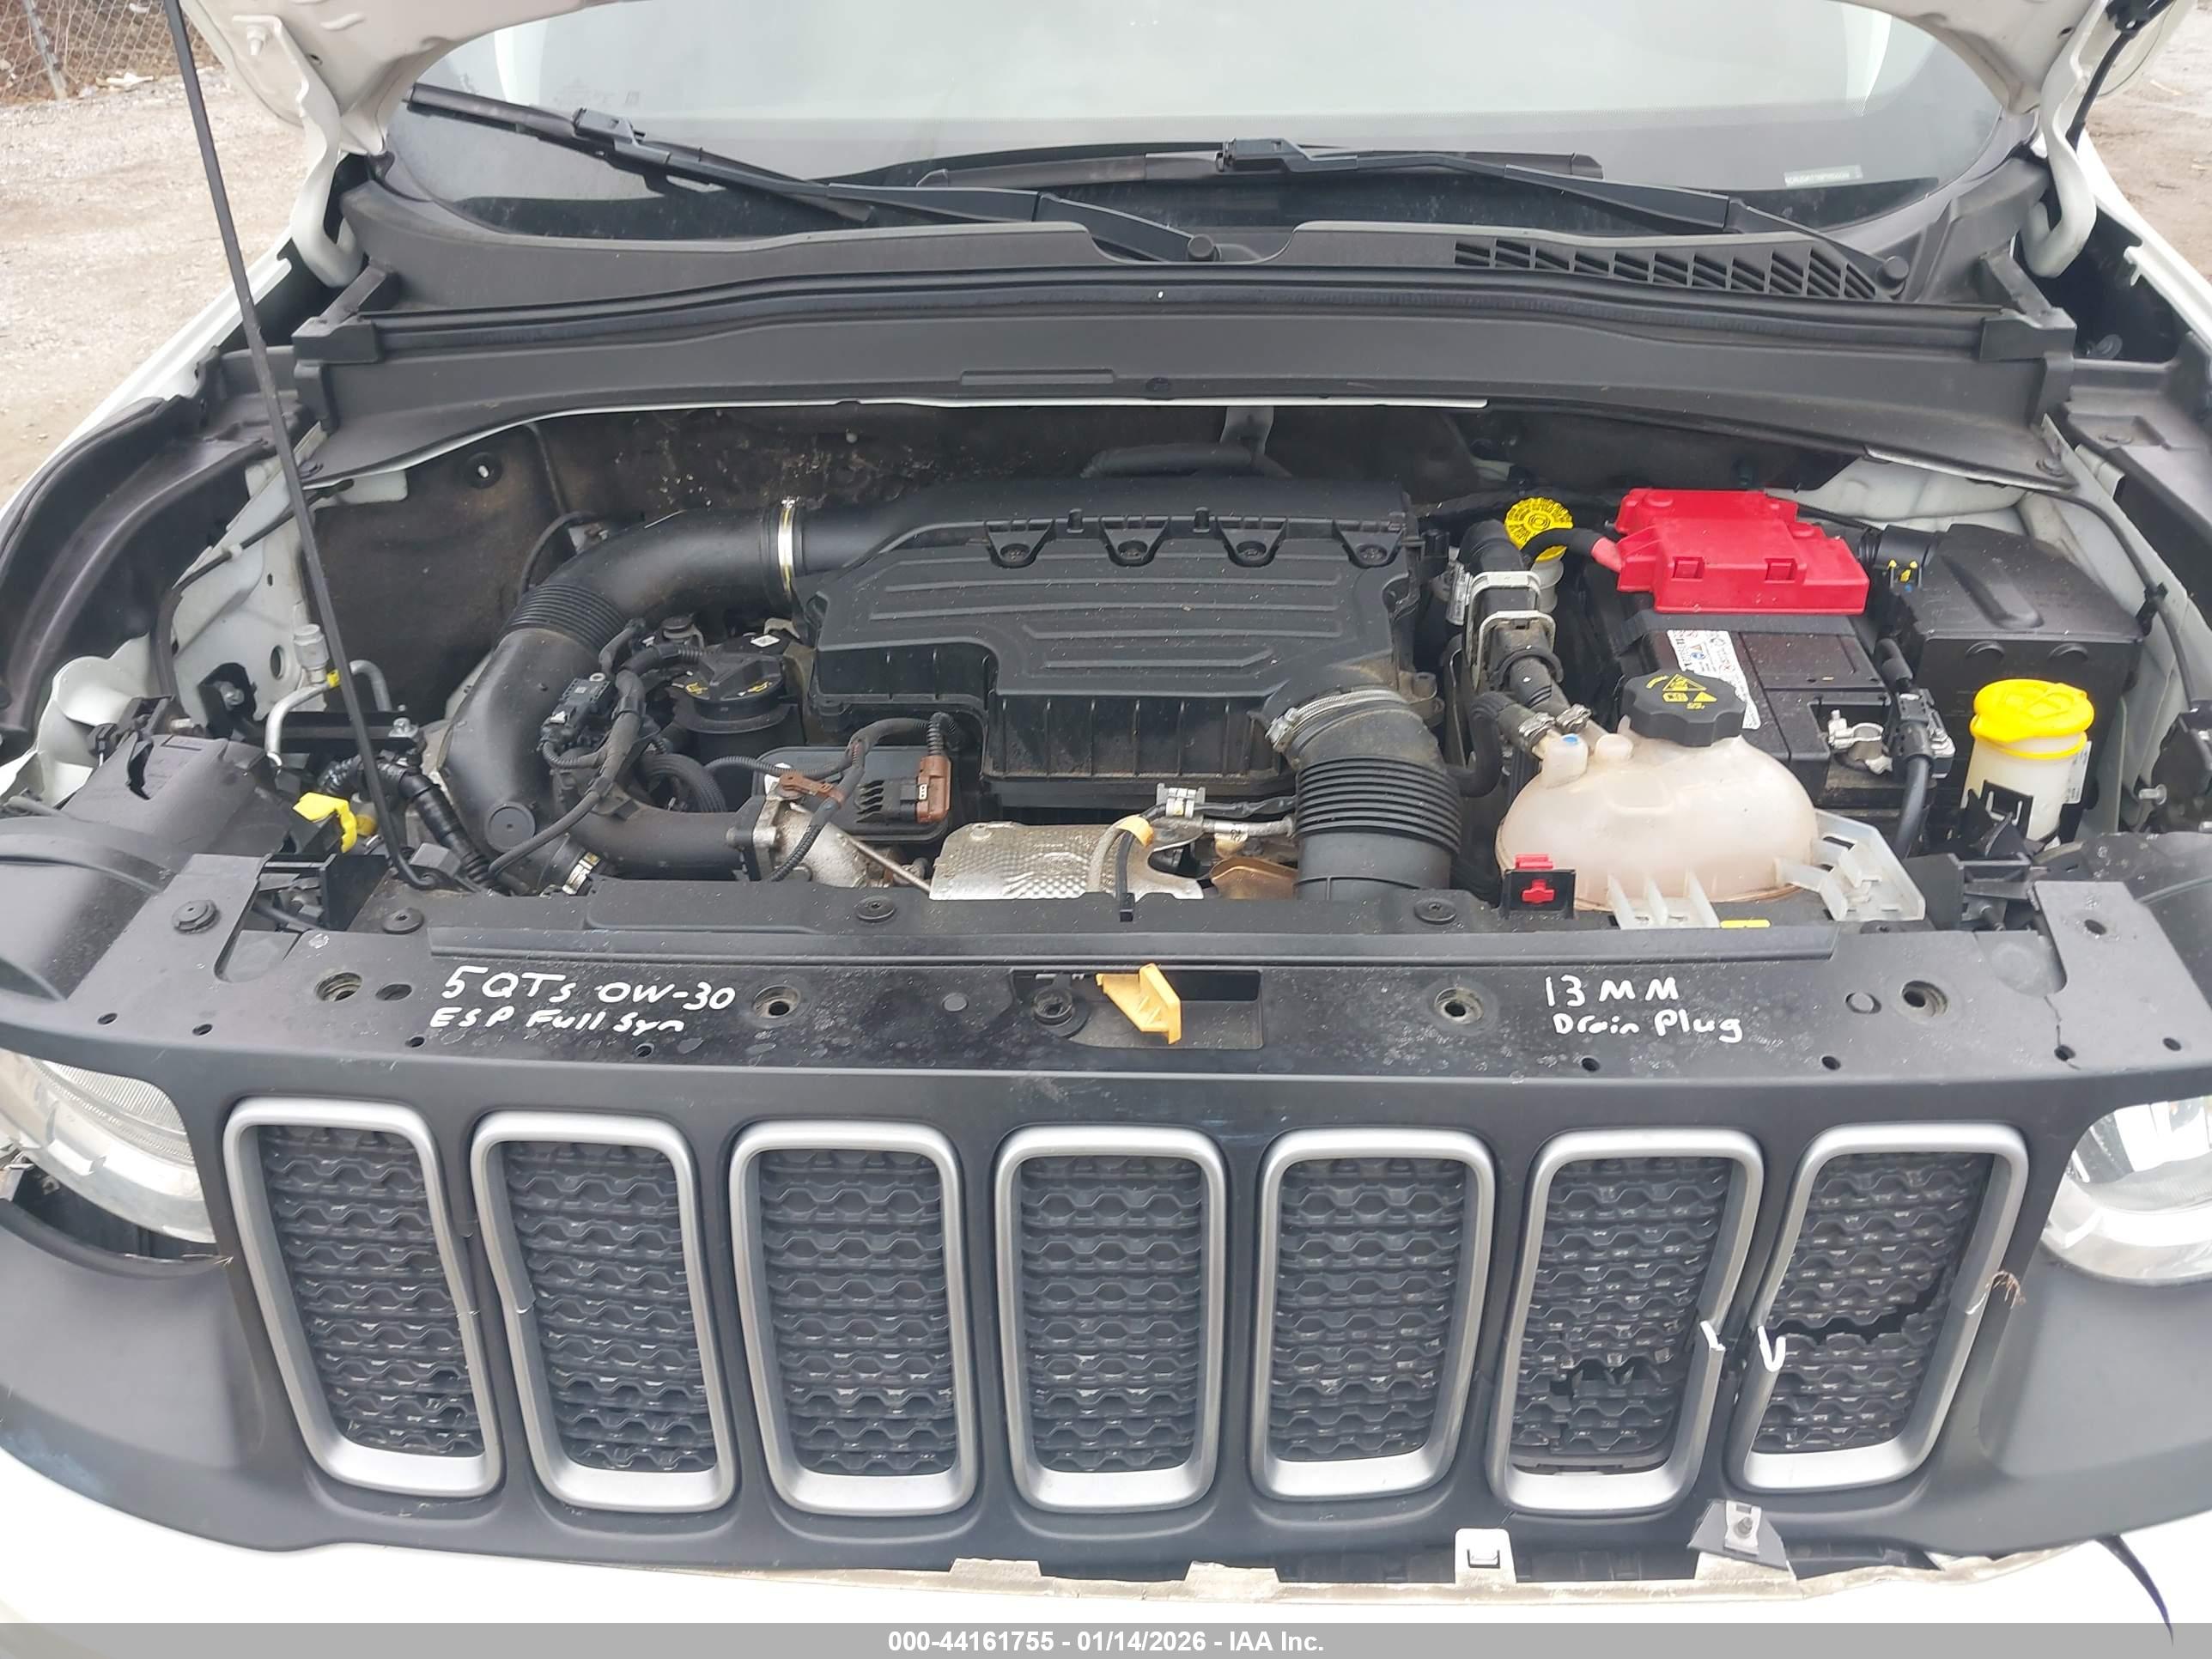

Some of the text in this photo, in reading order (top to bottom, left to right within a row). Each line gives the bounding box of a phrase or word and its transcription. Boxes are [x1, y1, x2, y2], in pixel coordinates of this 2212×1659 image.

[429, 1006, 515, 1028] ESP
[526, 1009, 606, 1030] Full
[1553, 1008, 1743, 1043] Drain Plug
